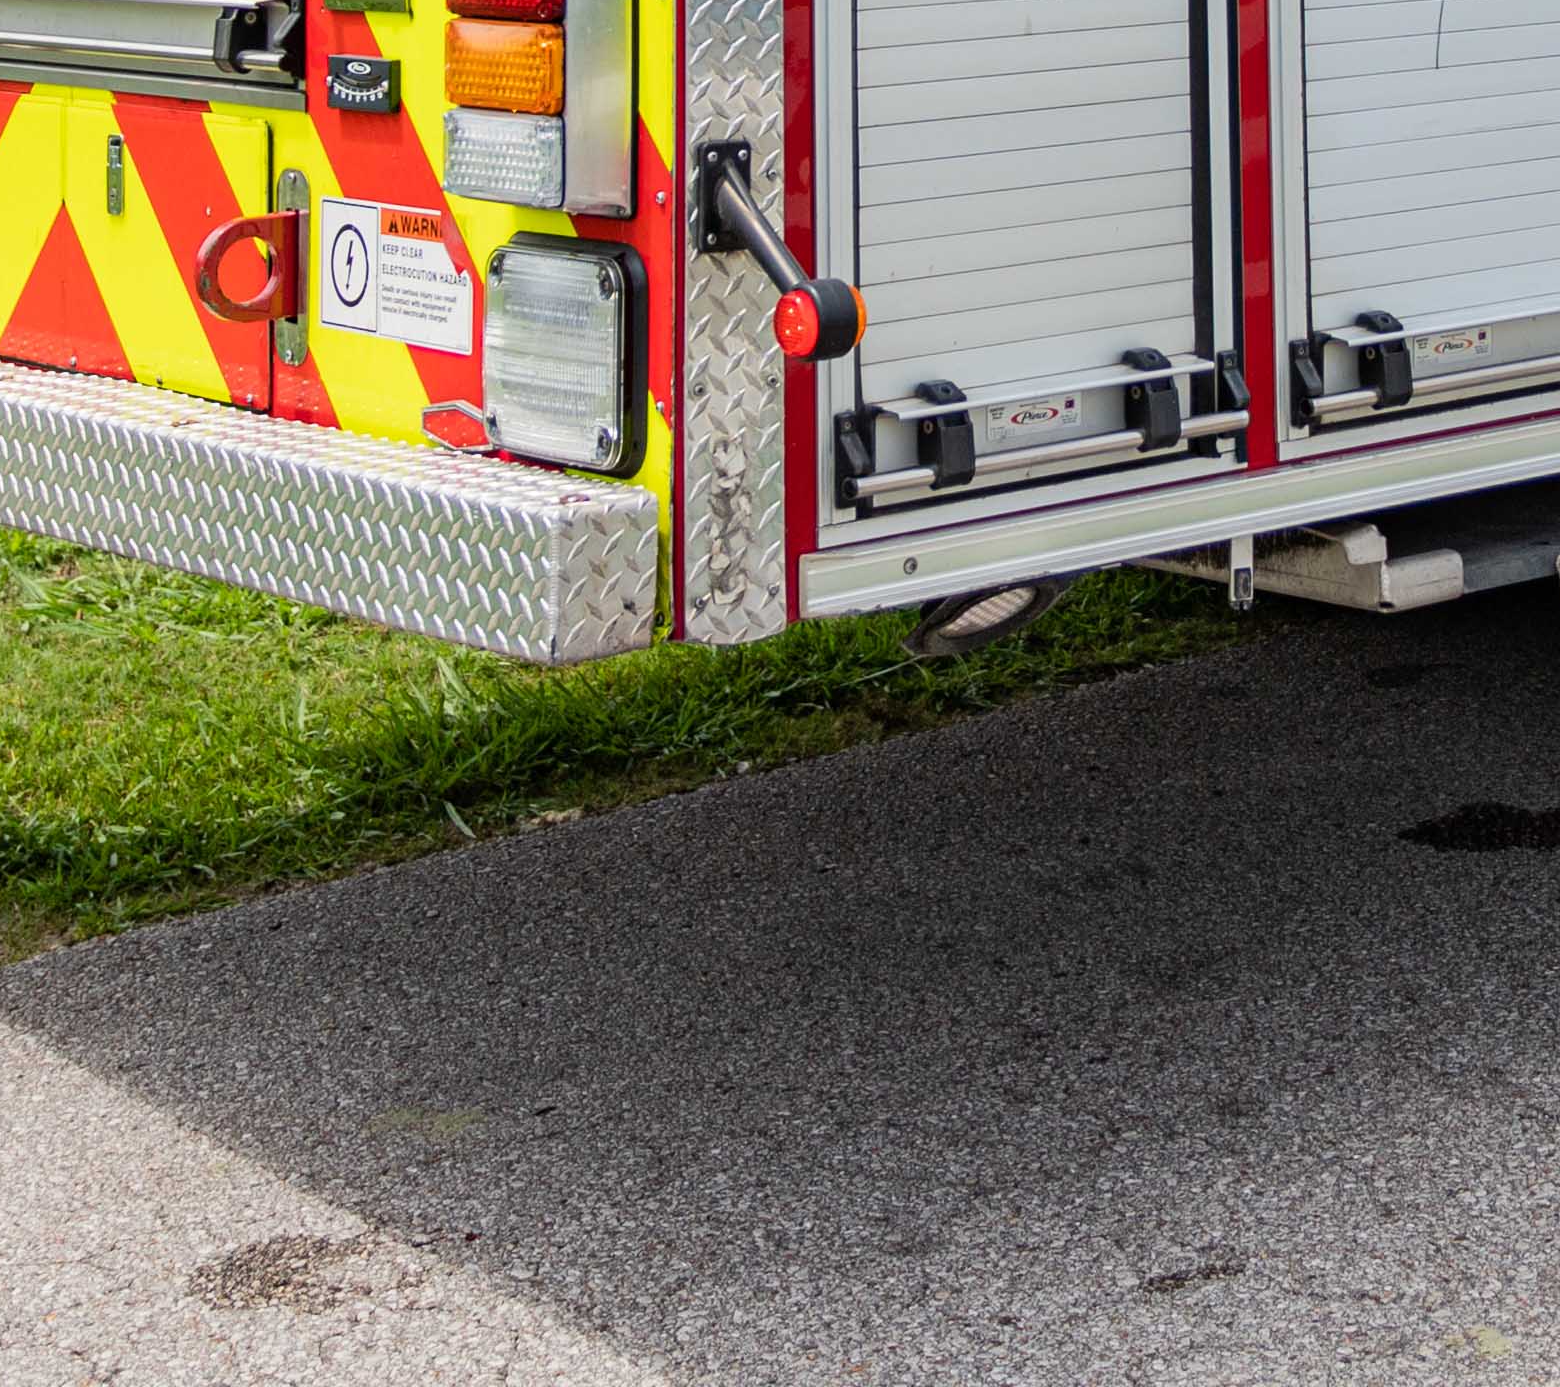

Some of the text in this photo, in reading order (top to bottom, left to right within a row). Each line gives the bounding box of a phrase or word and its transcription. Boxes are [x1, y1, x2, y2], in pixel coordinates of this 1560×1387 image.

[382, 244, 423, 259] KEEP CLEAR
[382, 264, 438, 282] ELECTROCUTION
